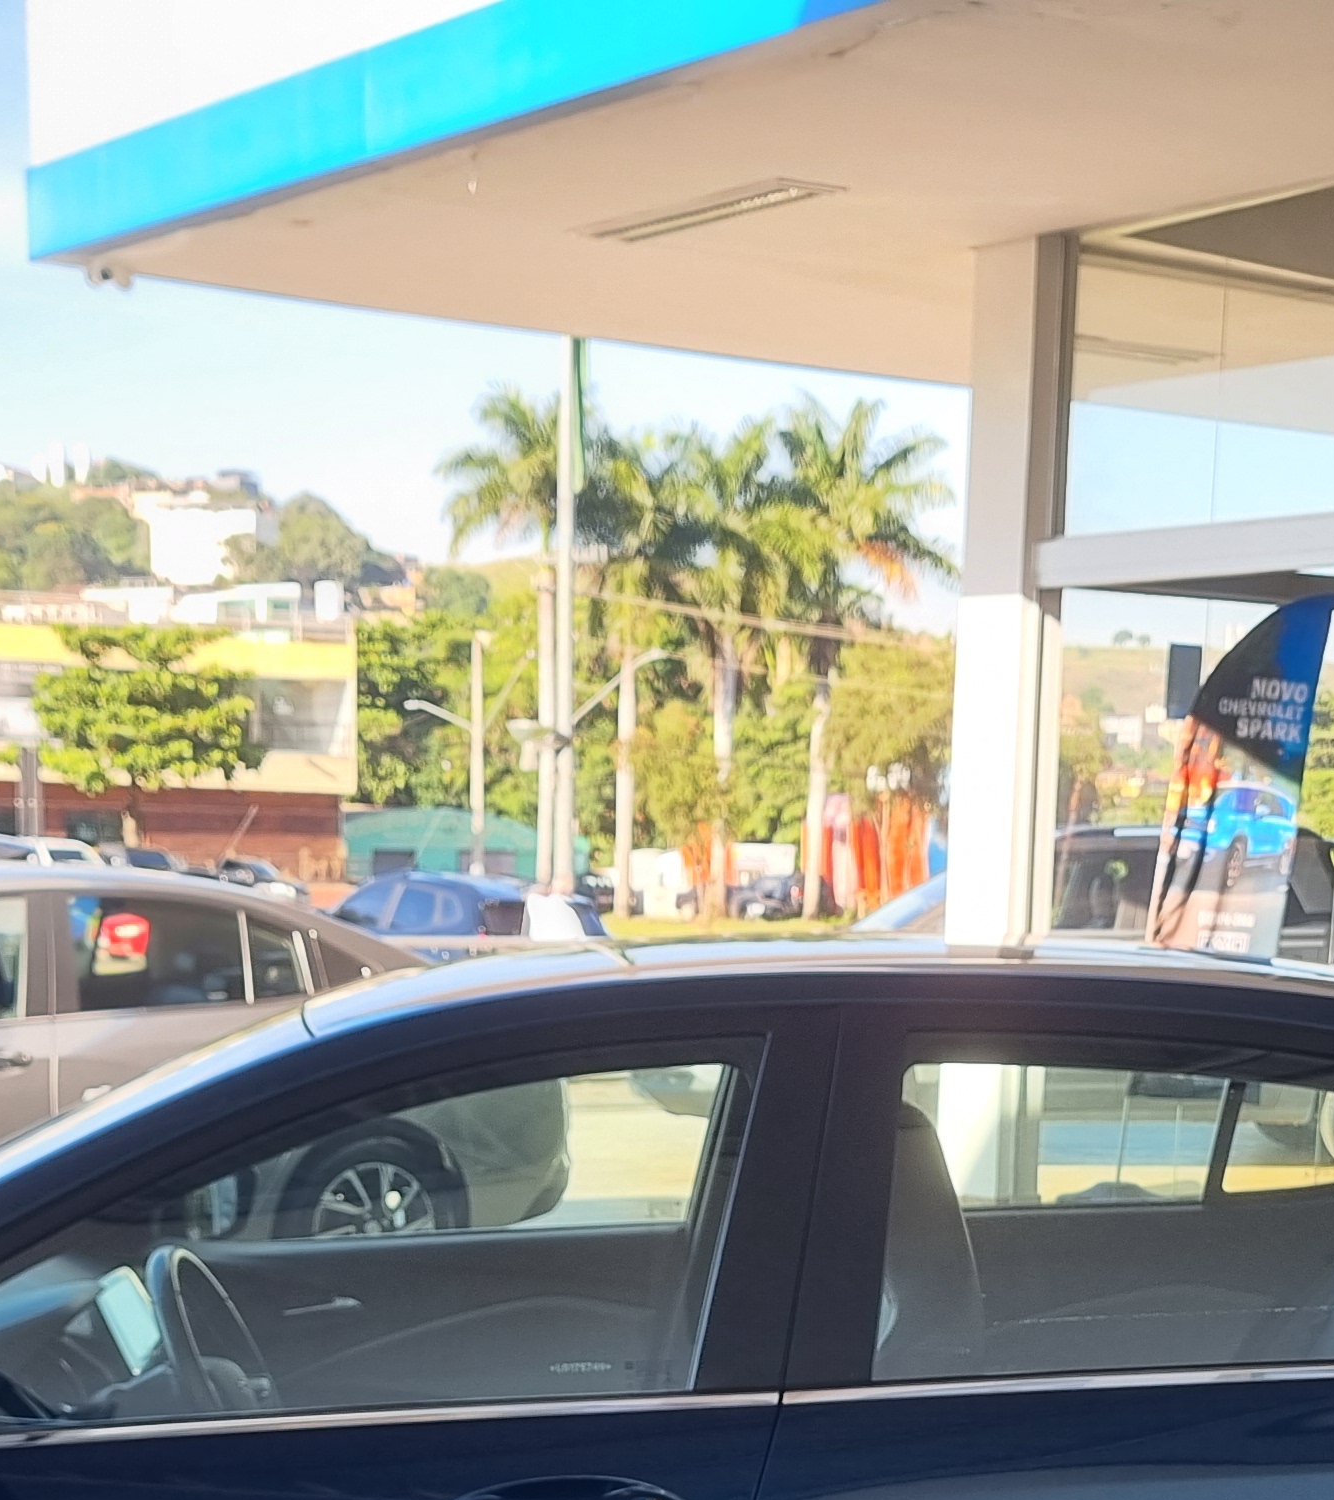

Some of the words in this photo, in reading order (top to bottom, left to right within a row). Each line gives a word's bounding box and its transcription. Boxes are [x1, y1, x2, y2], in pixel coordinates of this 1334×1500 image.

[1250, 676, 1309, 704] NOVO
[1218, 697, 1305, 721] CHEVROLET
[1236, 717, 1303, 744] SPARK
